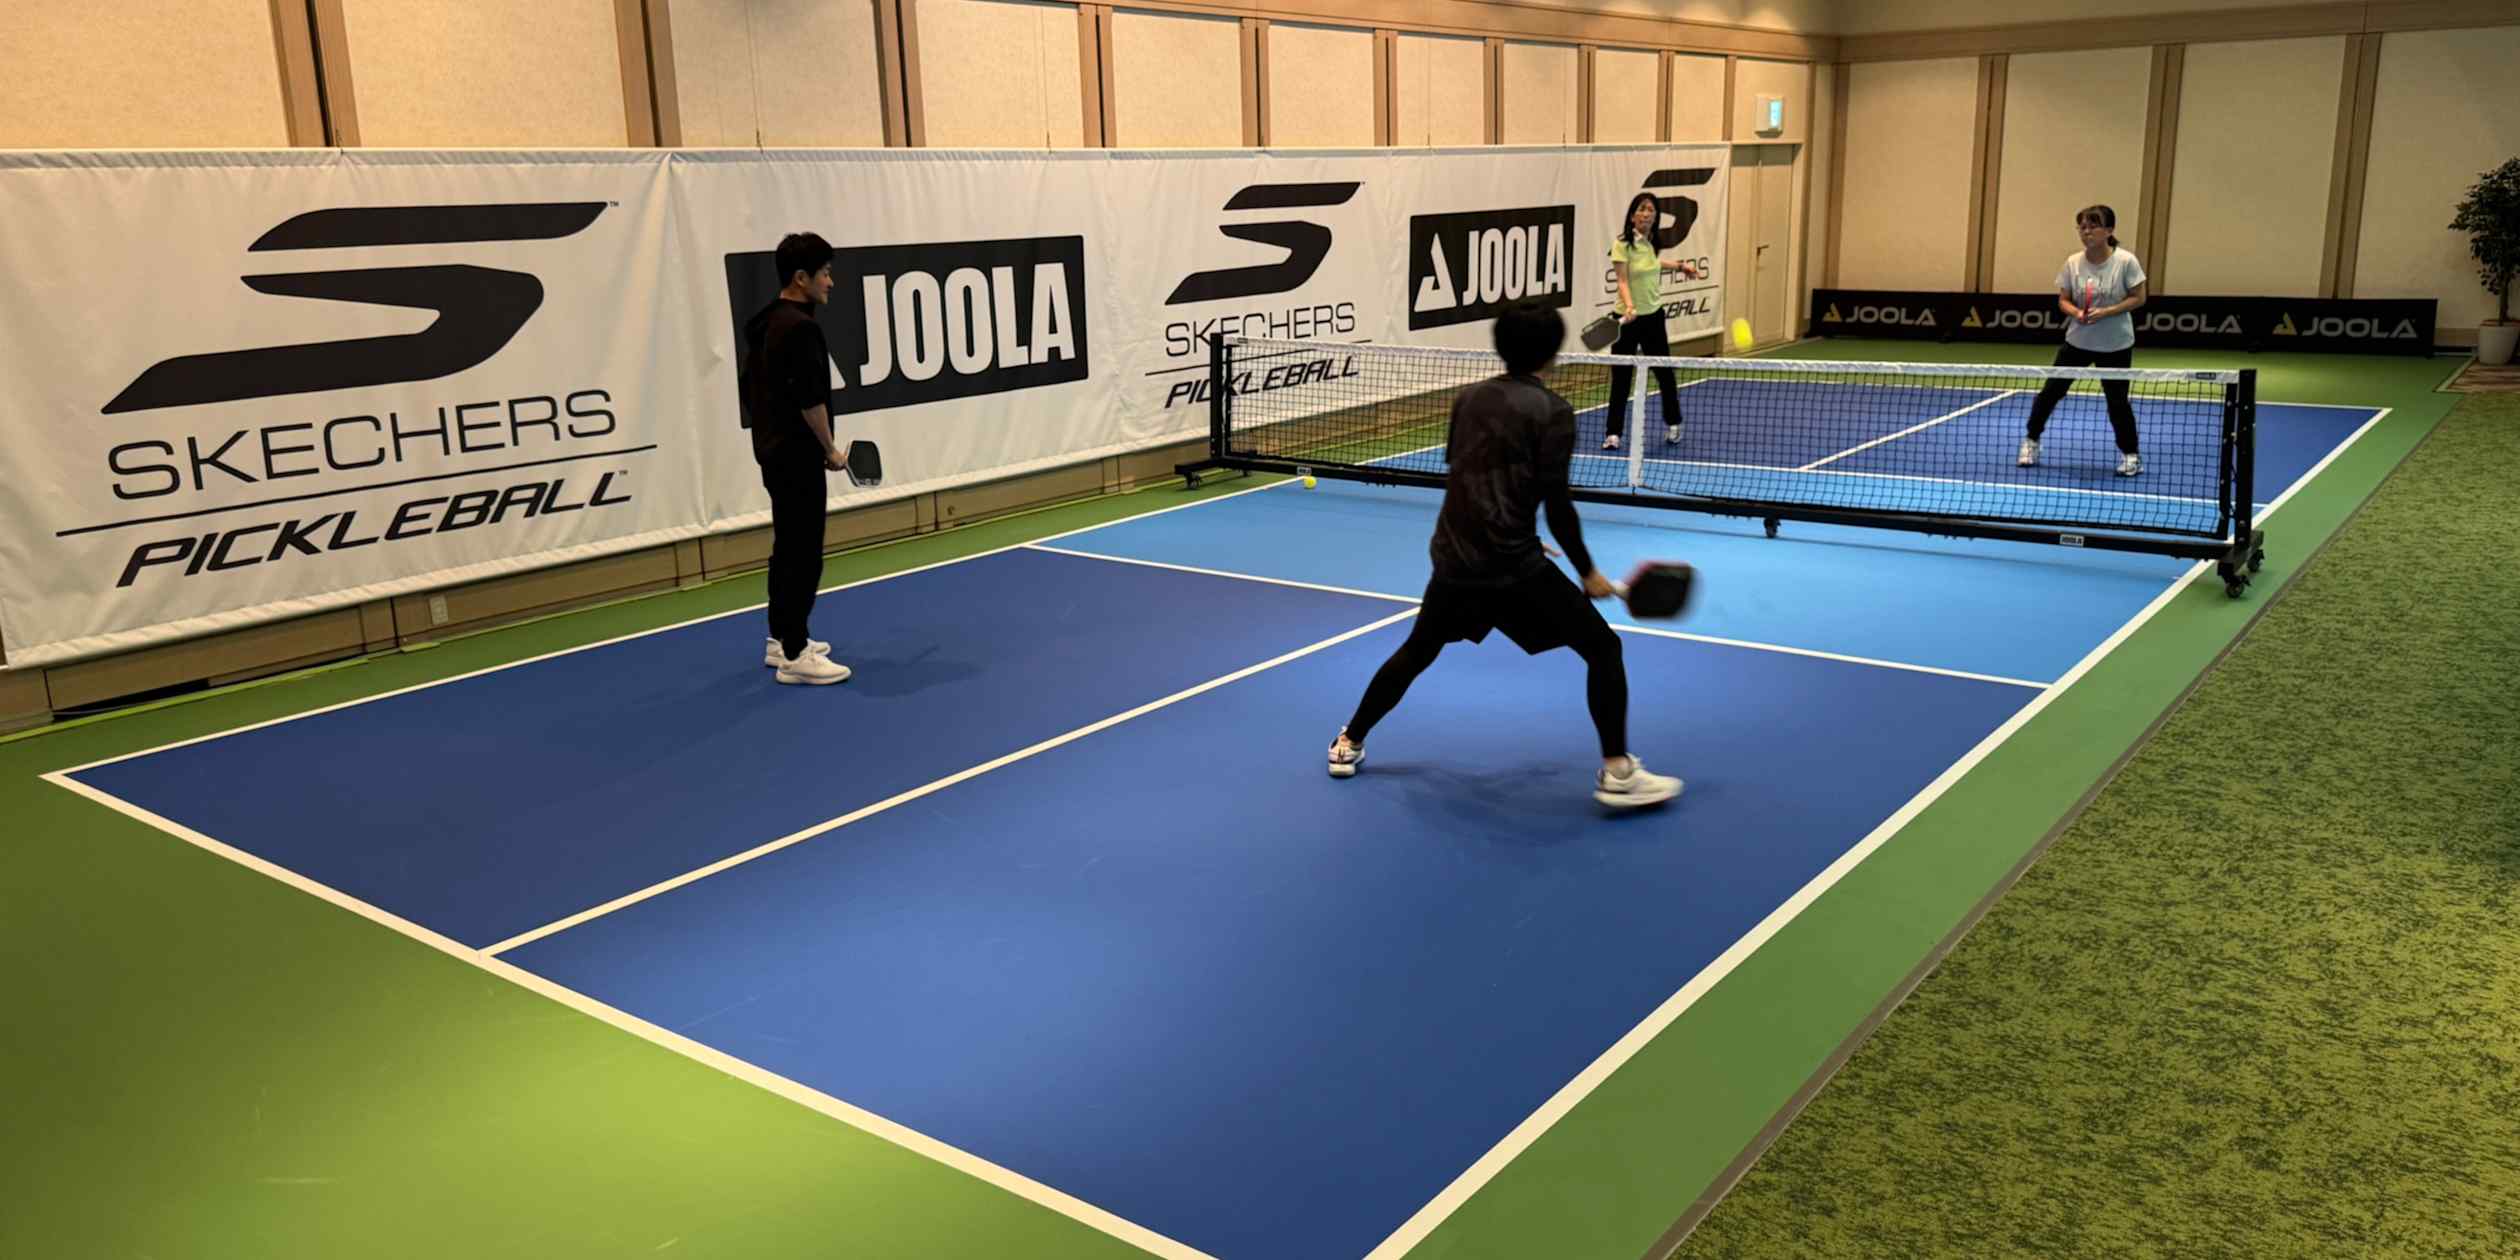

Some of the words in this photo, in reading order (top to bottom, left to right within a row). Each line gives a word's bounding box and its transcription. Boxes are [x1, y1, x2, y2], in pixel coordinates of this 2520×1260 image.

[1462, 223, 1566, 306] JOOLA
[859, 262, 1076, 386] JOOLA
[1845, 306, 1937, 326] JOOLA
[2135, 313, 2243, 333] JOOLA
[2301, 317, 2418, 338] JOOLA
[108, 389, 616, 500] SKECHERS
[116, 471, 633, 588] PICKLEBALL
